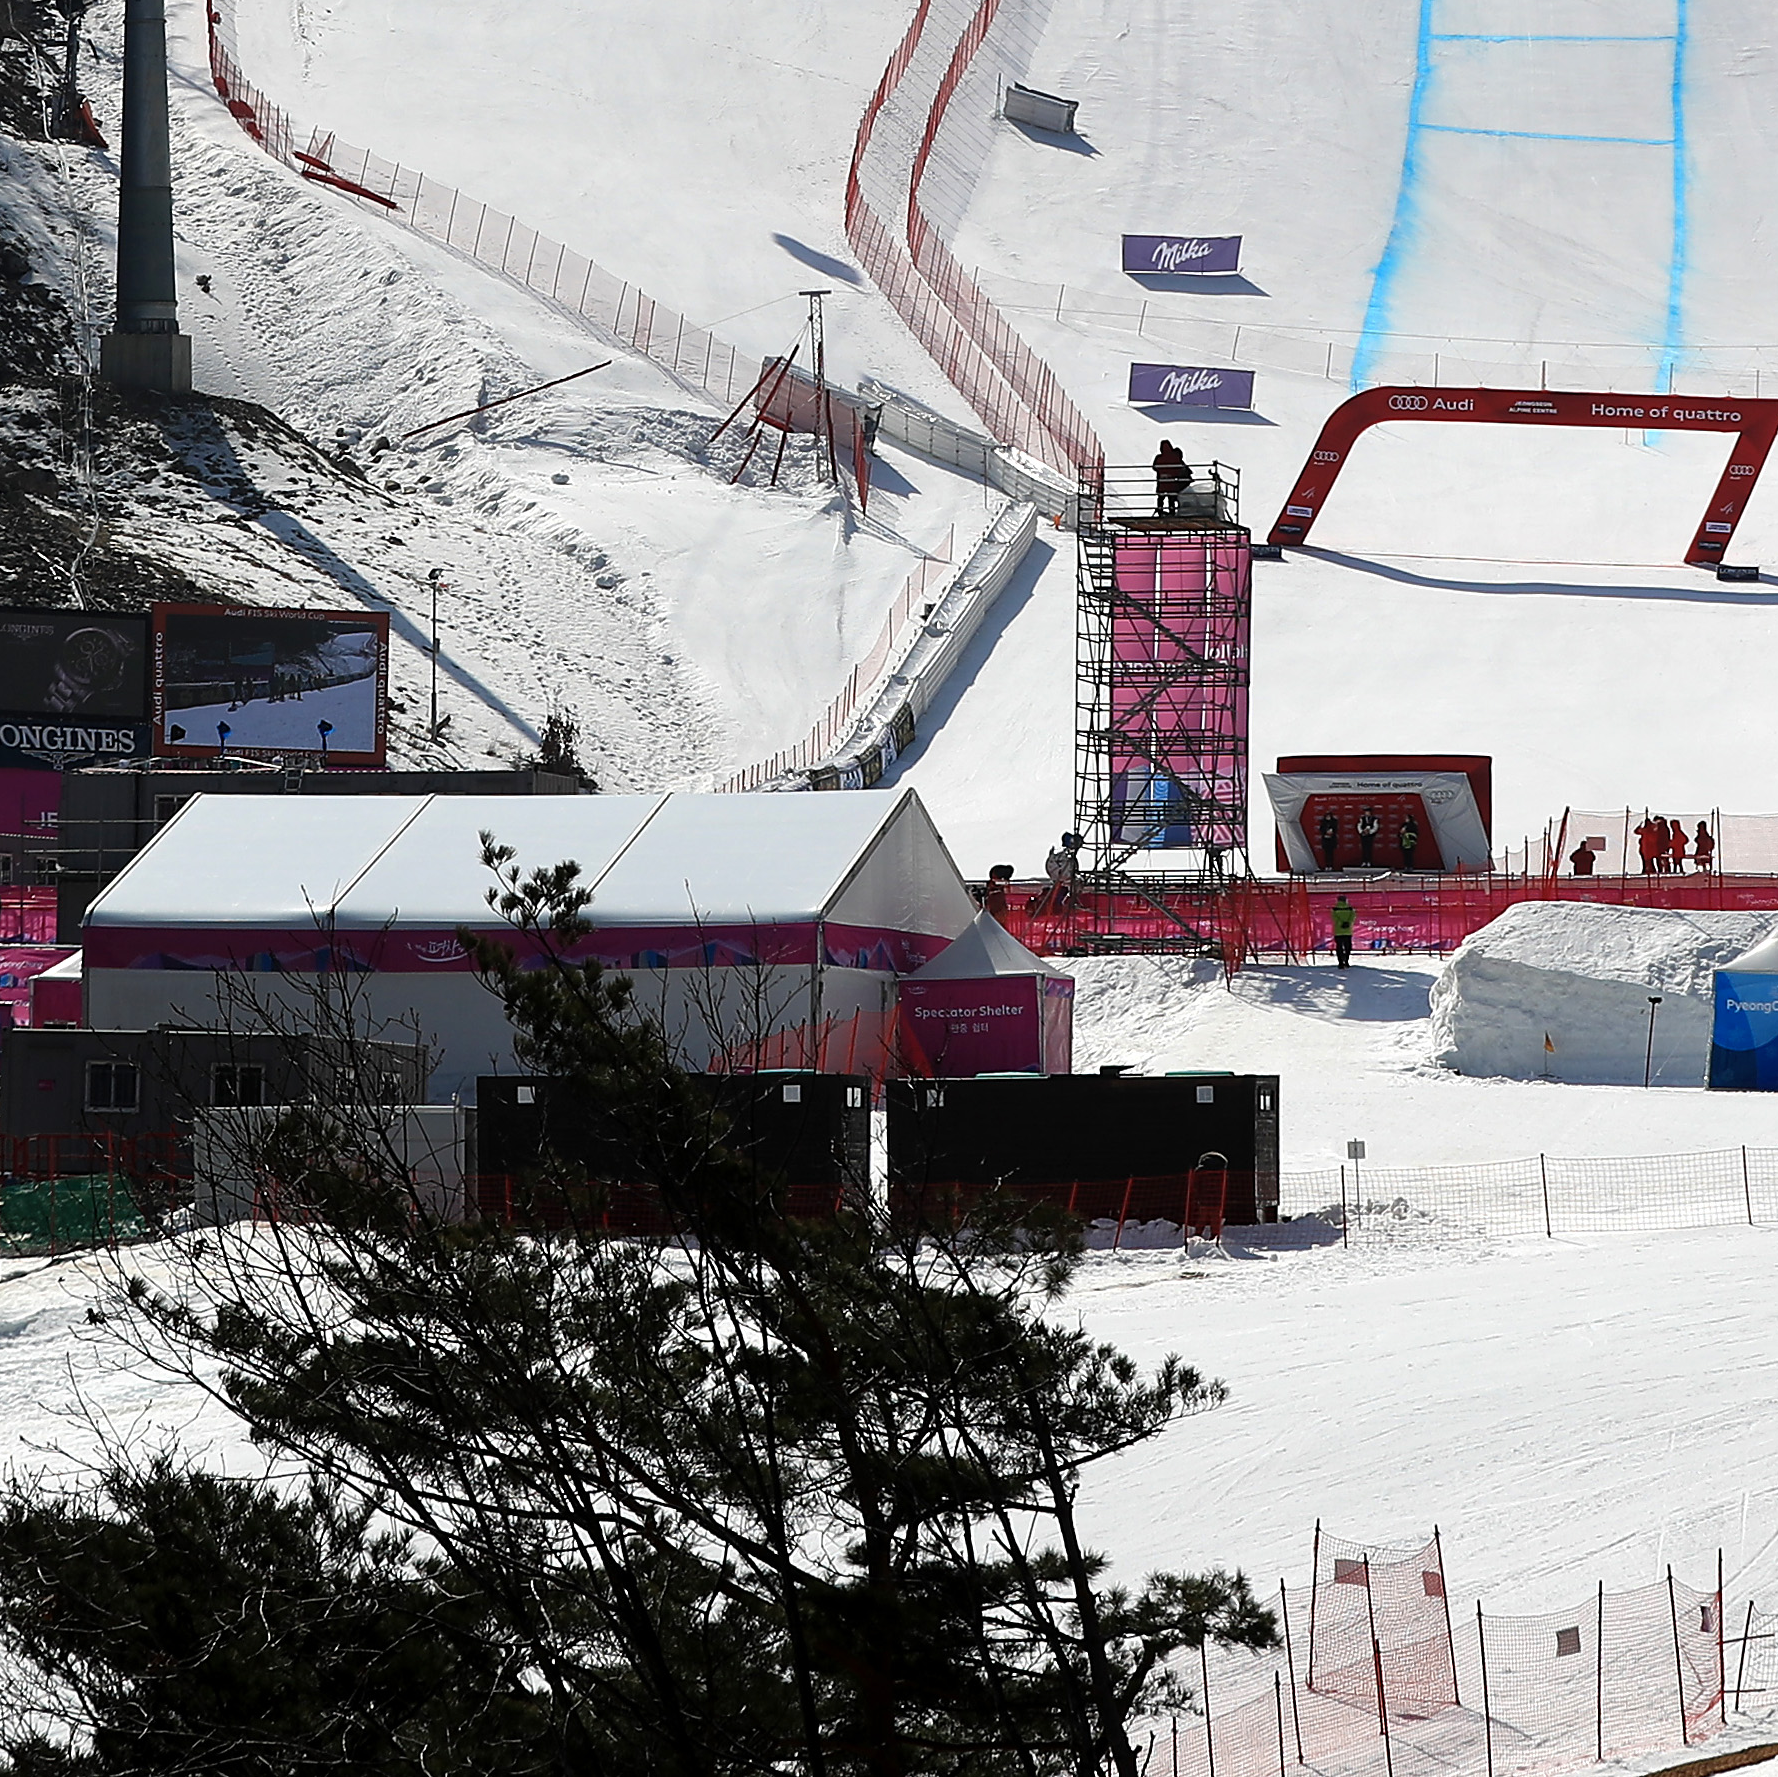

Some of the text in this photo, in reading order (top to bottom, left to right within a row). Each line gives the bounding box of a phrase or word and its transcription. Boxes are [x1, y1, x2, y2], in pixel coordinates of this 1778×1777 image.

[1151, 239, 1213, 271] Milka
[1159, 369, 1223, 403] Milka
[1432, 396, 1475, 412] Audi
[1590, 402, 1743, 423] Home of quattro
[224, 608, 325, 621] Audi FIS Ski World Cup
[153, 632, 165, 726] Audi quattro
[377, 642, 389, 735] Audi quattro
[979, 1004, 1024, 1017] Shelter
